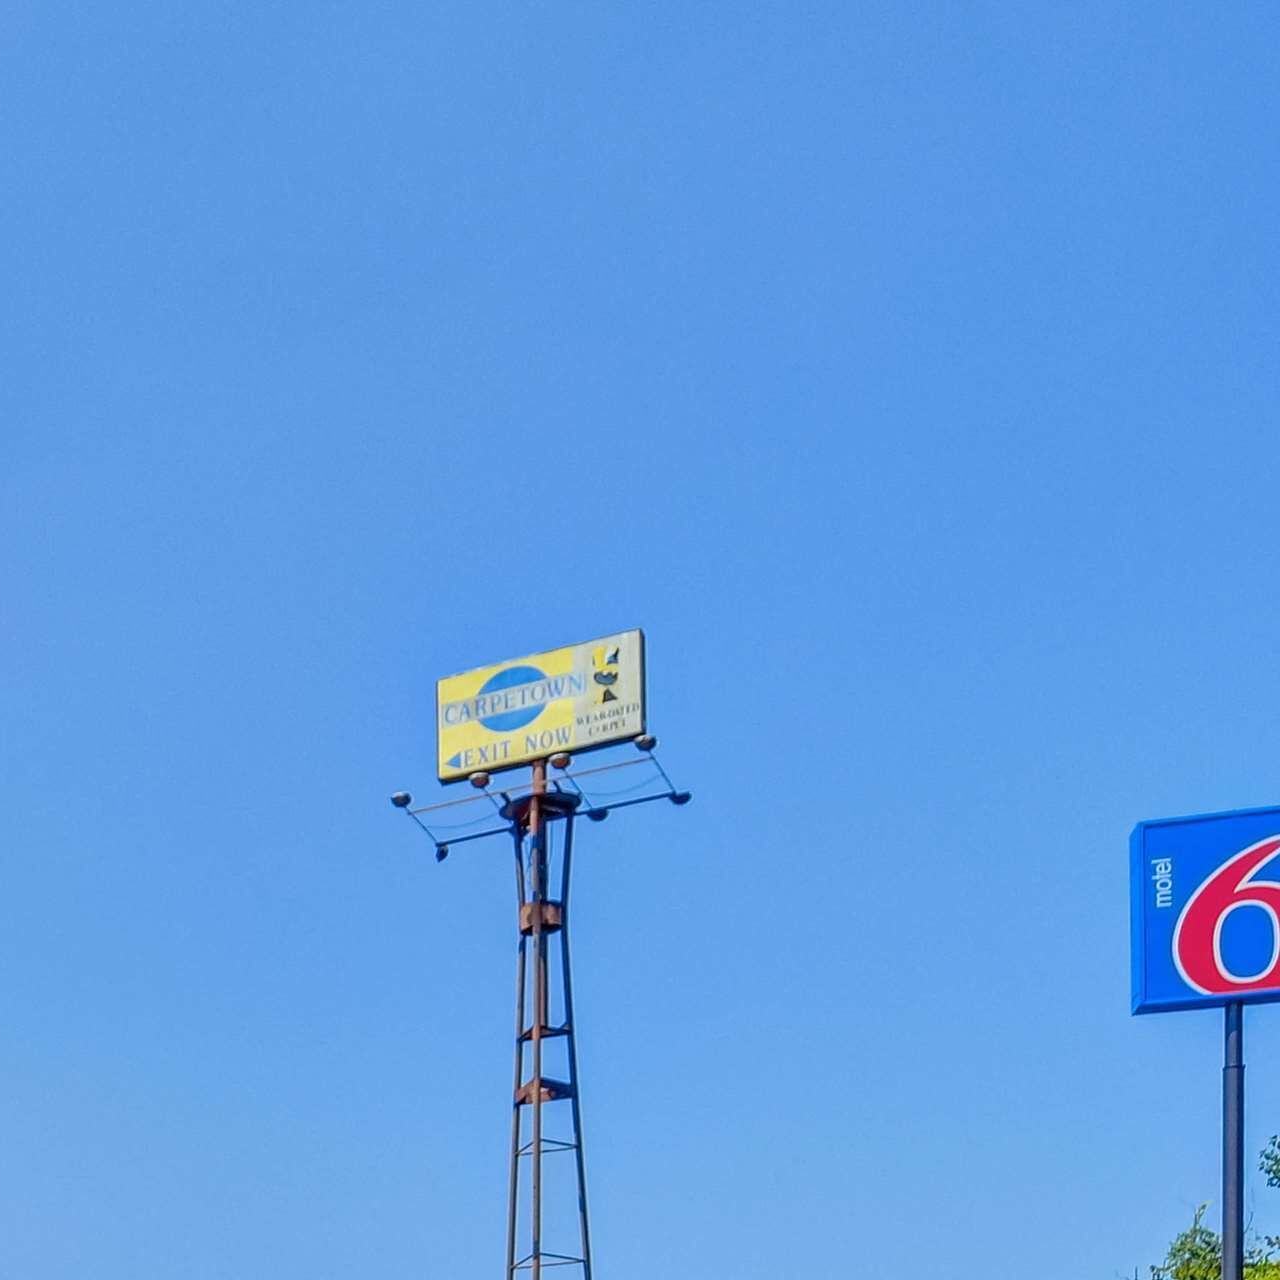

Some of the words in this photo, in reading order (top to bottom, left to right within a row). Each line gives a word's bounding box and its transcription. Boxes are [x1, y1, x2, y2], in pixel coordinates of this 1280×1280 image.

[444, 672, 586, 723] CARPETOWN
[464, 740, 511, 768] EXIT
[525, 726, 572, 753] NOW
[1151, 856, 1173, 908] motel
[1172, 832, 1280, 996] 6
